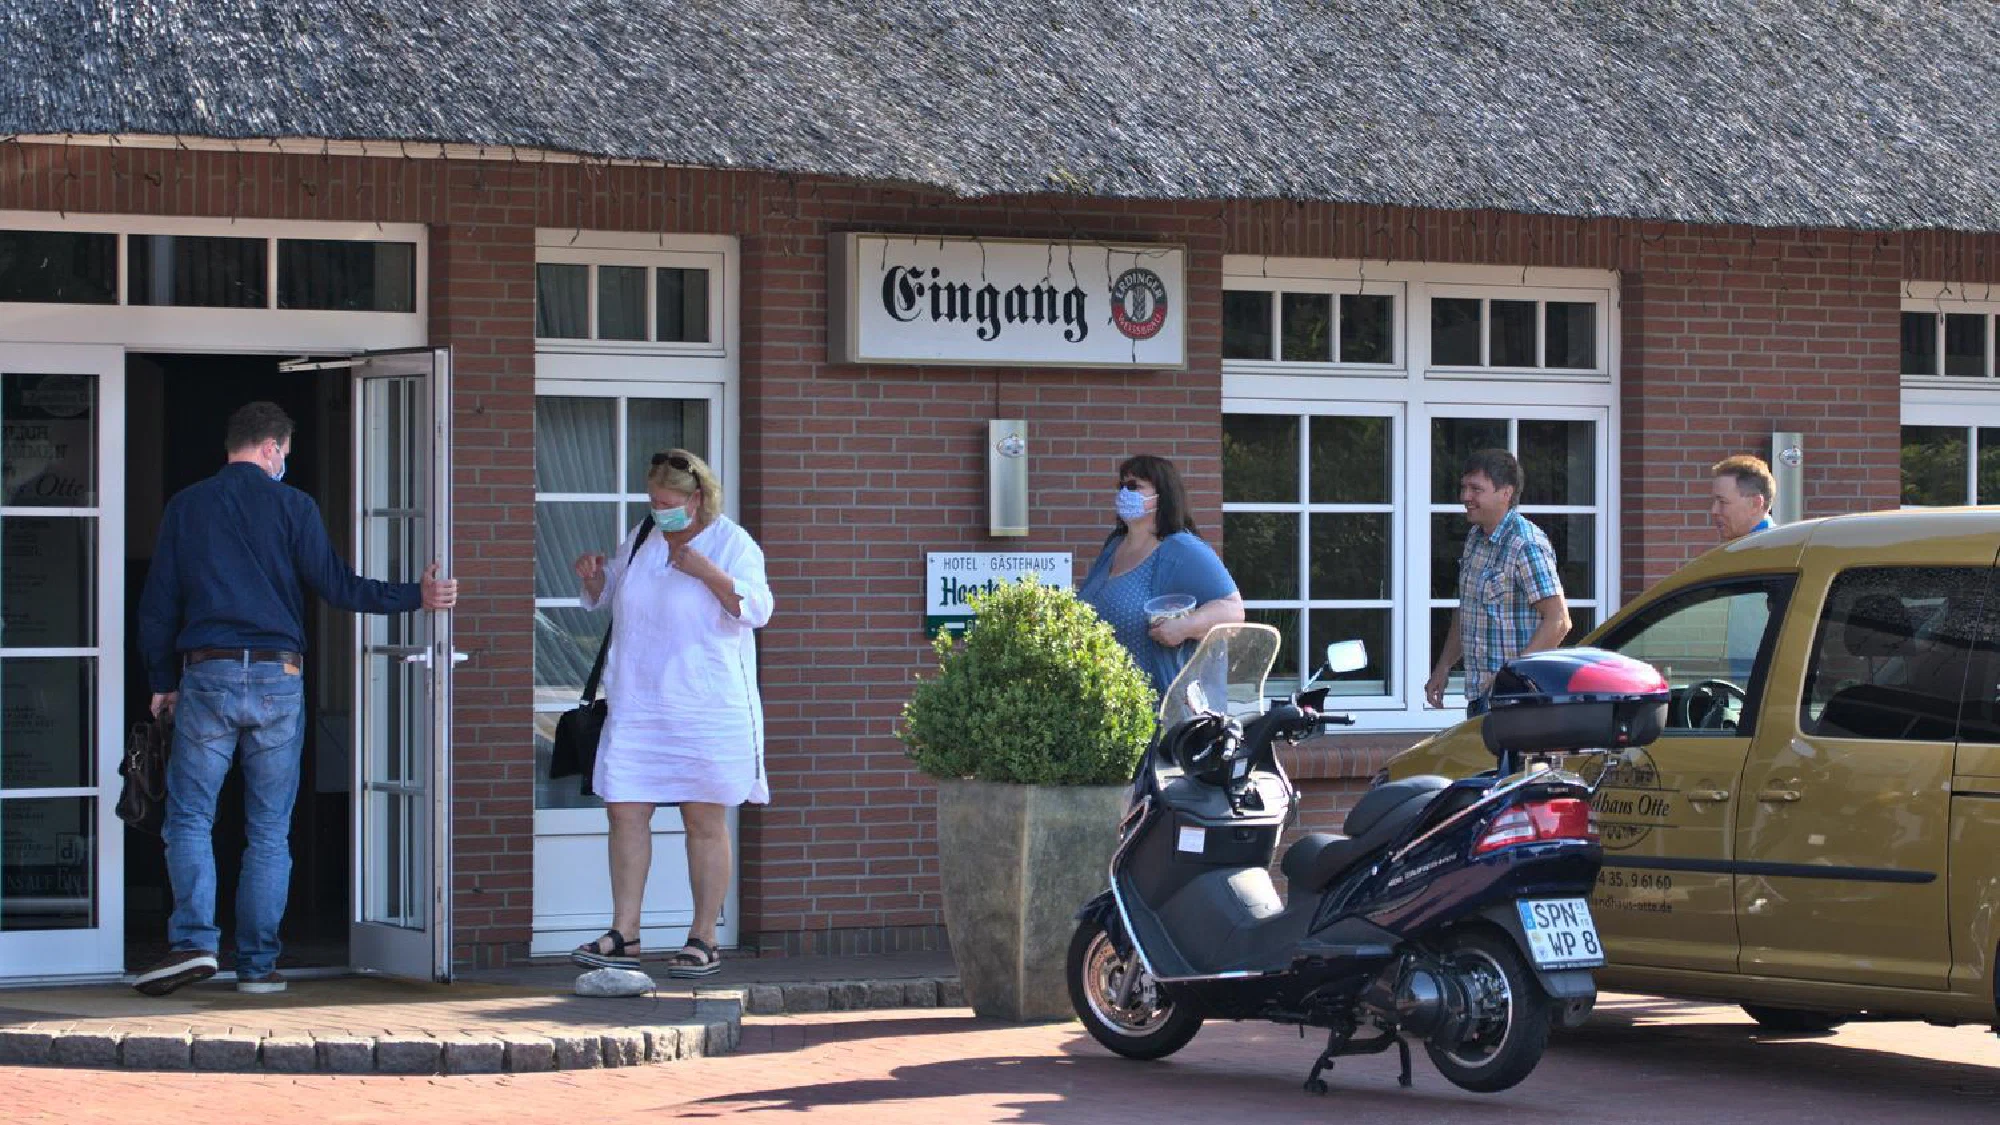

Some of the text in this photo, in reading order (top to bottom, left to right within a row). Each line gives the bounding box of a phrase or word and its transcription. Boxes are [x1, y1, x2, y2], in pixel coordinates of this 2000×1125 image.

[1115, 272, 1164, 299] ERDINGER
[882, 265, 1089, 343] Eingang
[943, 555, 1056, 571] HOTEL GÄSTEHAUS
[1638, 794, 1670, 817] Otte
[1534, 902, 1579, 929] SPN
[1547, 930, 1598, 956] WP 8
